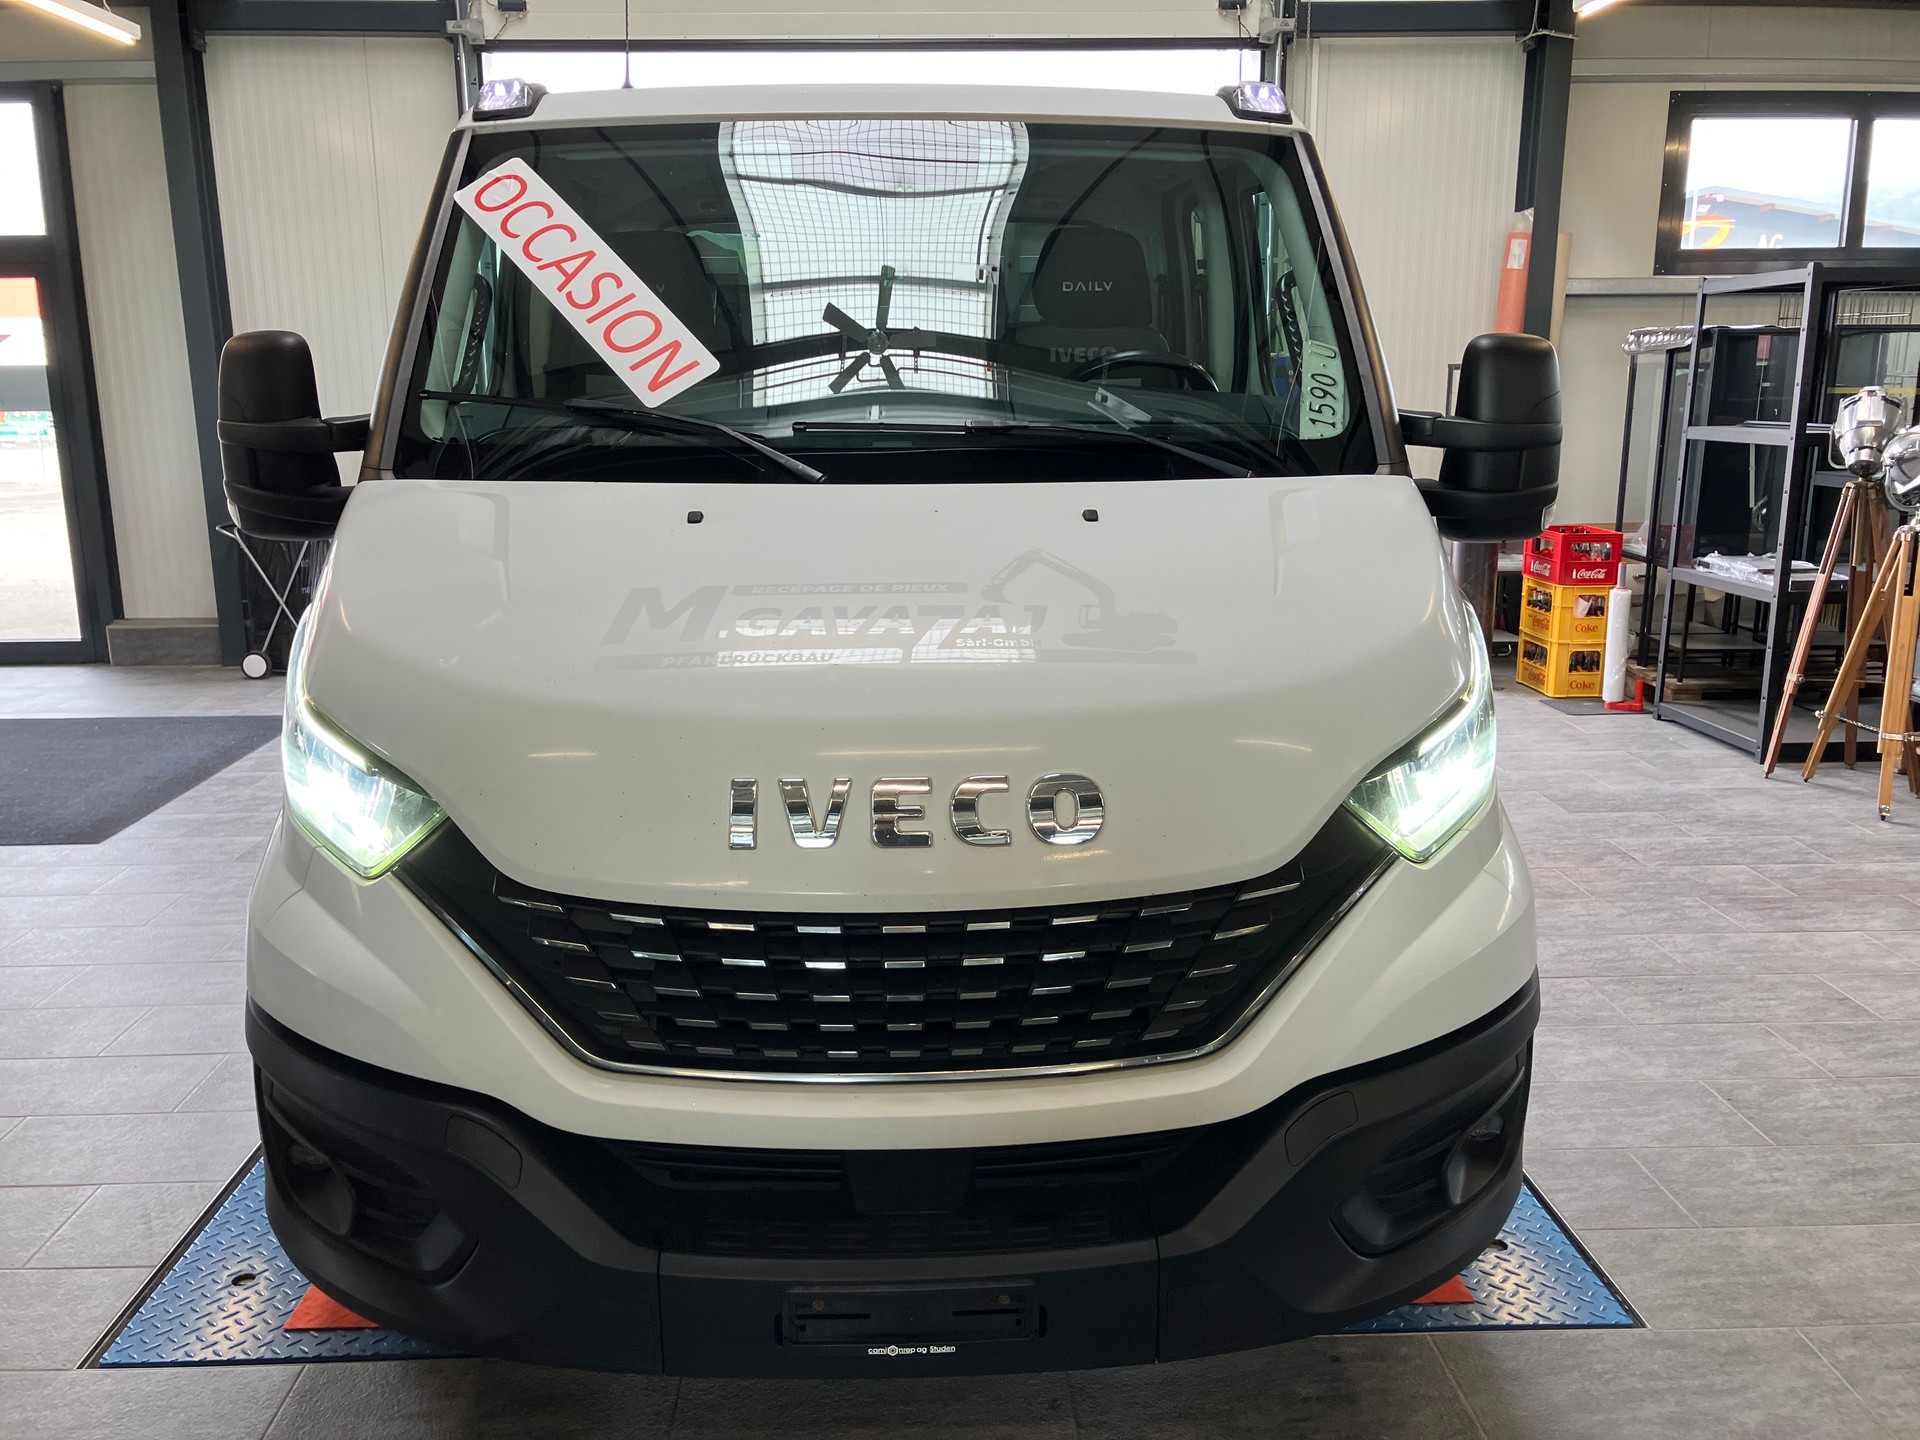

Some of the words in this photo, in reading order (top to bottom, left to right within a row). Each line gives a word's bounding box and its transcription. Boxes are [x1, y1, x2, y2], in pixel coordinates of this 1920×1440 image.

[474, 174, 701, 393] OCCASION
[1062, 281, 1113, 292] DAILY
[859, 584, 886, 593] DE
[892, 584, 950, 593] PIEUX
[1575, 623, 1599, 633] Coke
[1569, 680, 1596, 690] Coke
[727, 773, 1105, 850] IVECO
